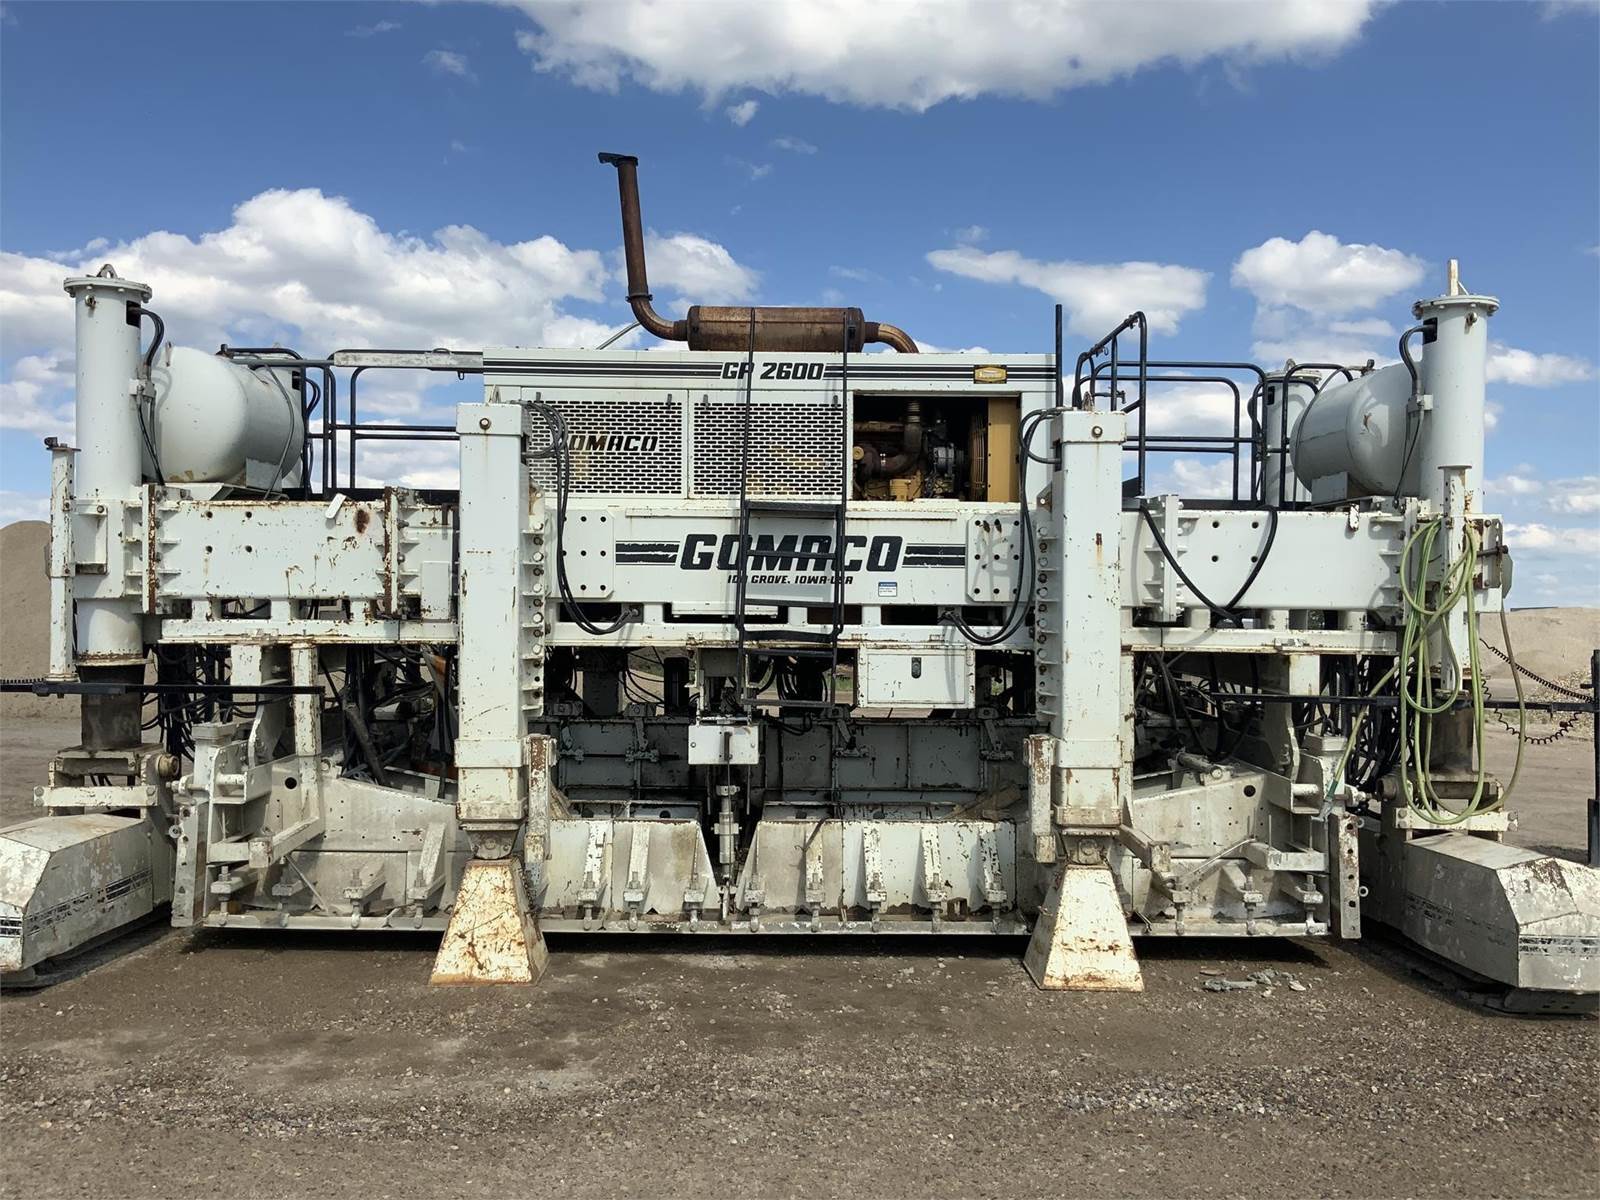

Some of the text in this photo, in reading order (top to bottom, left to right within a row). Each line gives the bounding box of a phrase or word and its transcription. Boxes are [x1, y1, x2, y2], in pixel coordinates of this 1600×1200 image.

[722, 362, 824, 380] GP 2600
[558, 435, 658, 451] OMACO
[680, 533, 903, 572] GOMACO
